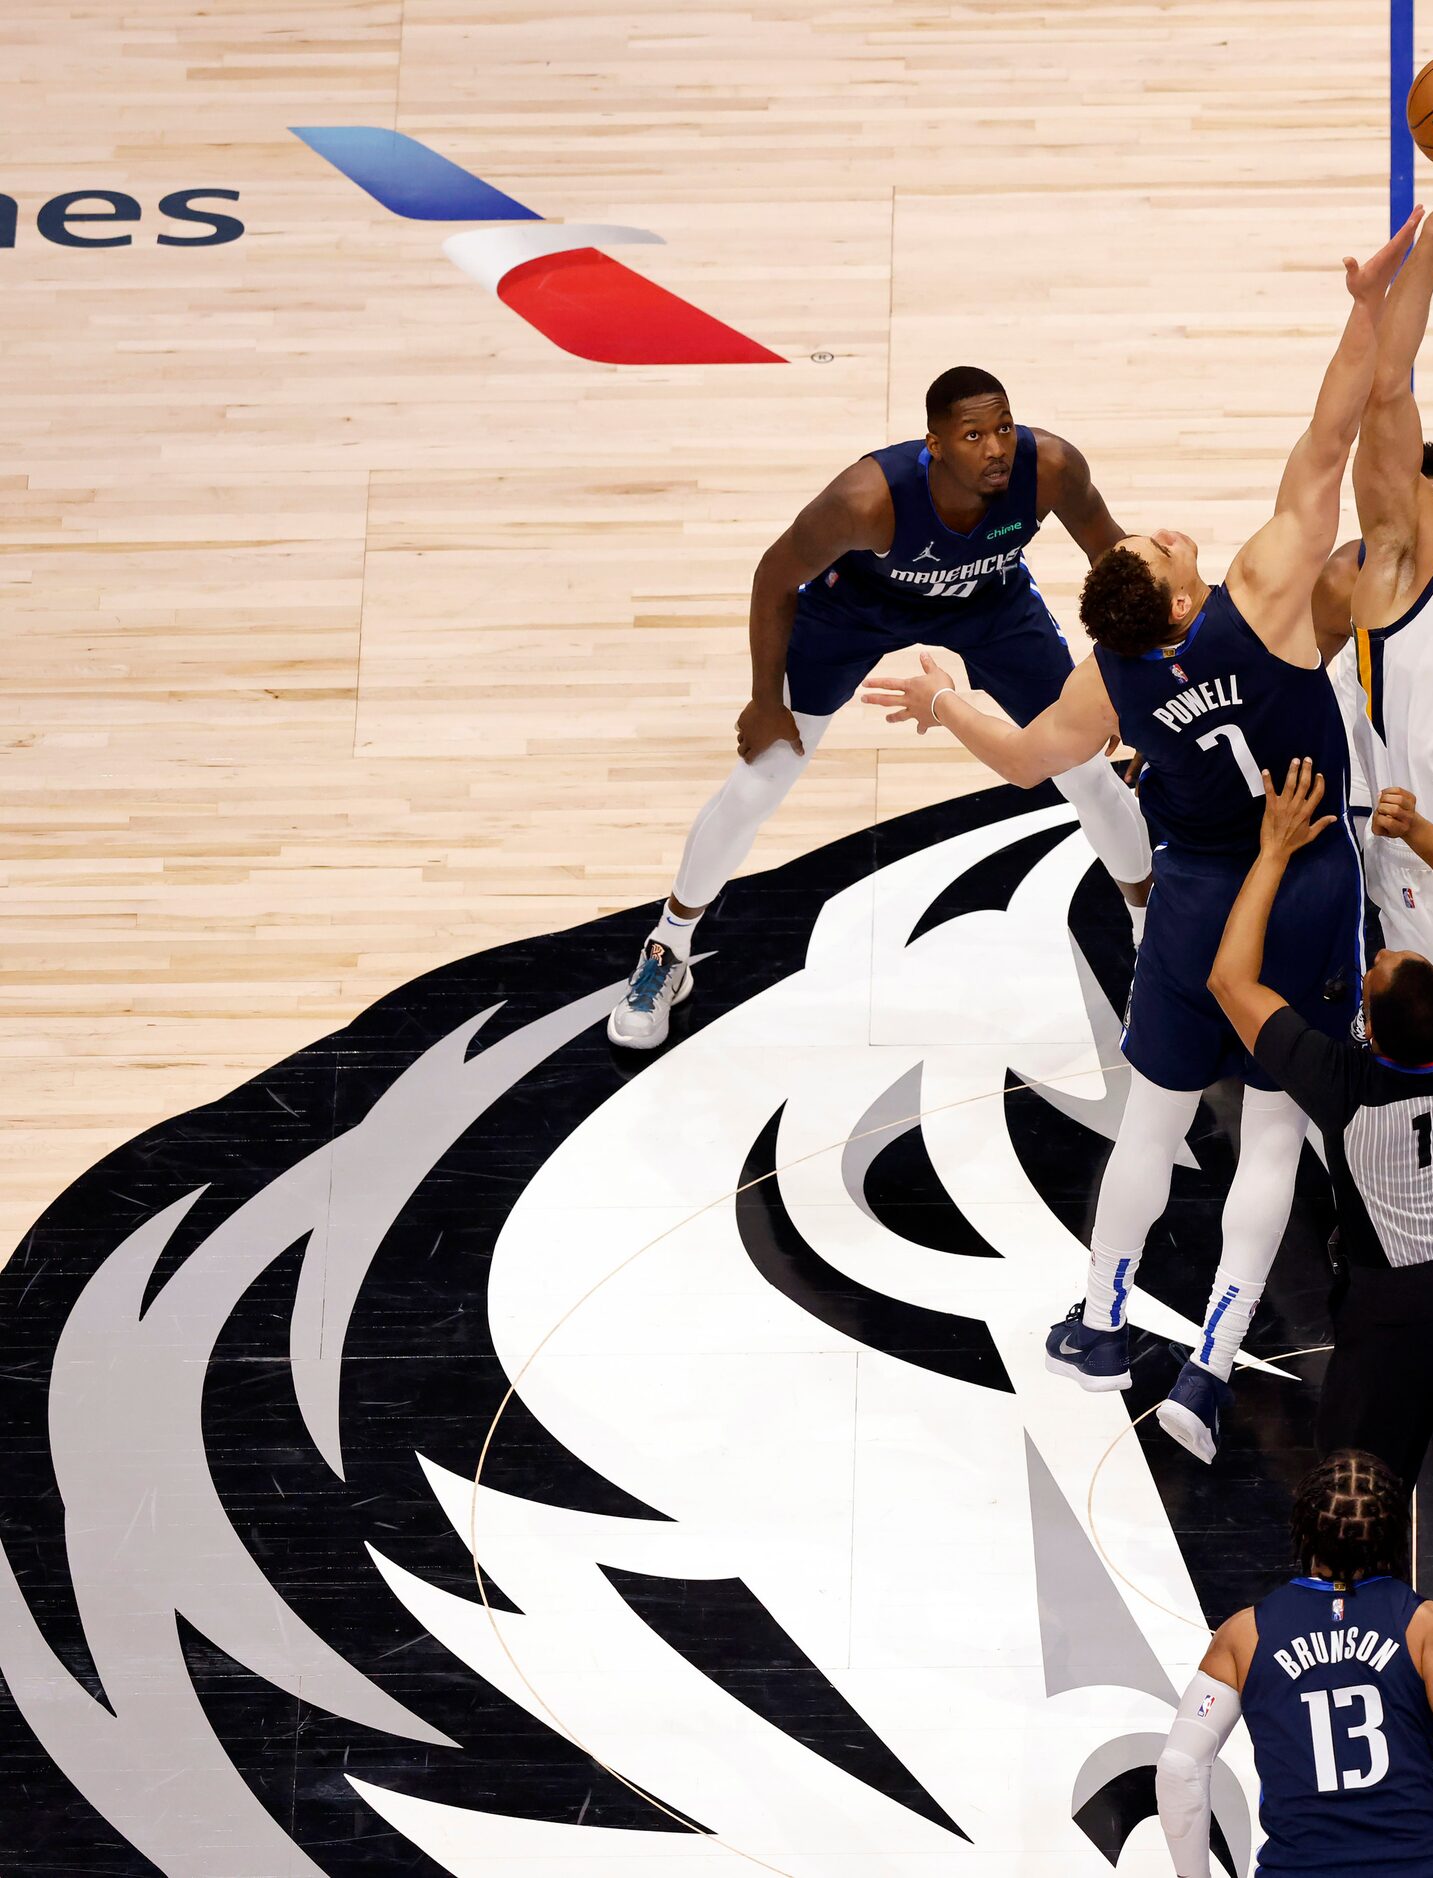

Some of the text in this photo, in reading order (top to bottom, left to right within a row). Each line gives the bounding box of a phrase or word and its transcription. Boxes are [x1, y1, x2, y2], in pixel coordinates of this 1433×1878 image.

[986, 521, 1023, 540] chime
[1152, 674, 1243, 733] POWELL
[1195, 723, 1266, 798] 7
[1273, 1626, 1400, 1680] BRUNSON
[1300, 1684, 1390, 1792] 13
